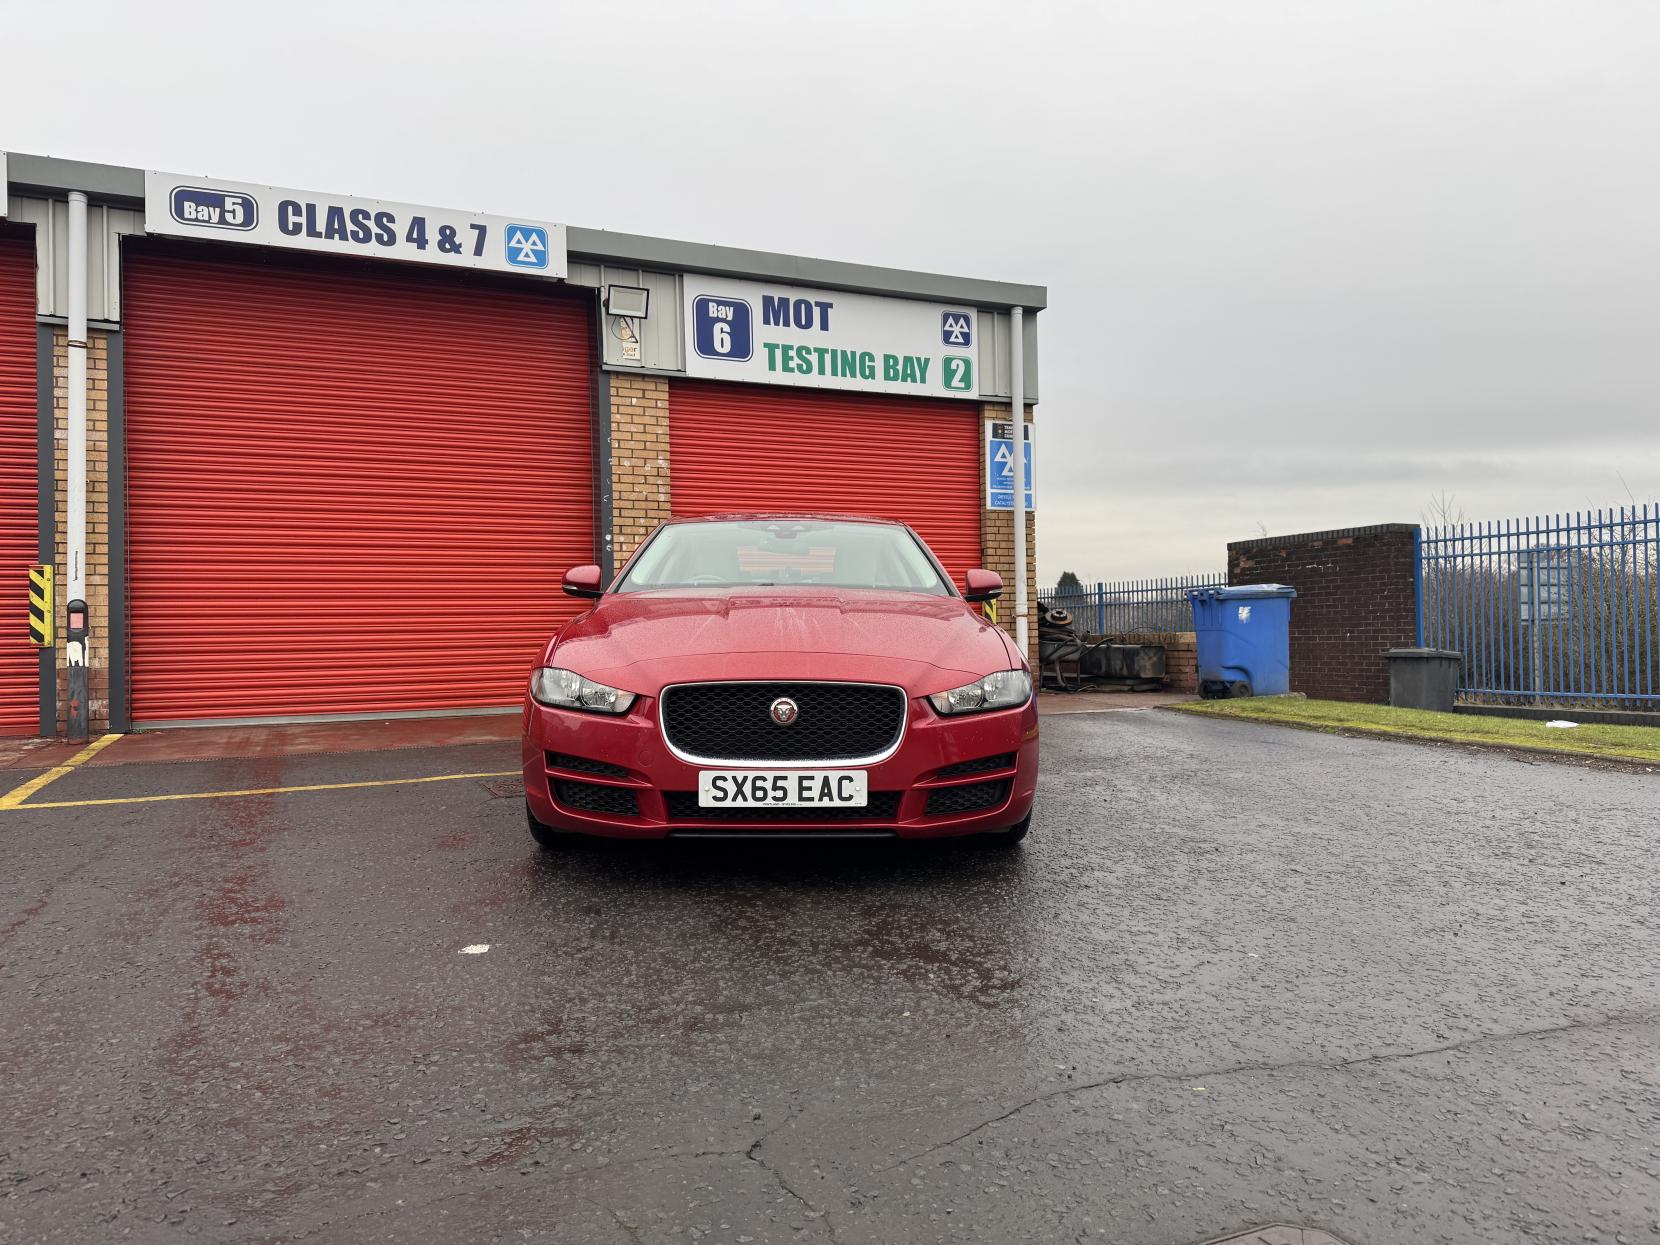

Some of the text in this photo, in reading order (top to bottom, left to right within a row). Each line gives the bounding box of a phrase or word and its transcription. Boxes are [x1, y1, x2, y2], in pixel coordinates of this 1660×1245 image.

[183, 196, 244, 224] Bay 5
[277, 200, 488, 256] CLASS 4 & 7
[708, 302, 734, 321] Bay
[761, 295, 834, 332] MOT
[712, 322, 732, 354] 6
[763, 342, 931, 384] TESTING BAY
[950, 358, 966, 388] 2
[711, 775, 854, 803] SX65 EAC
